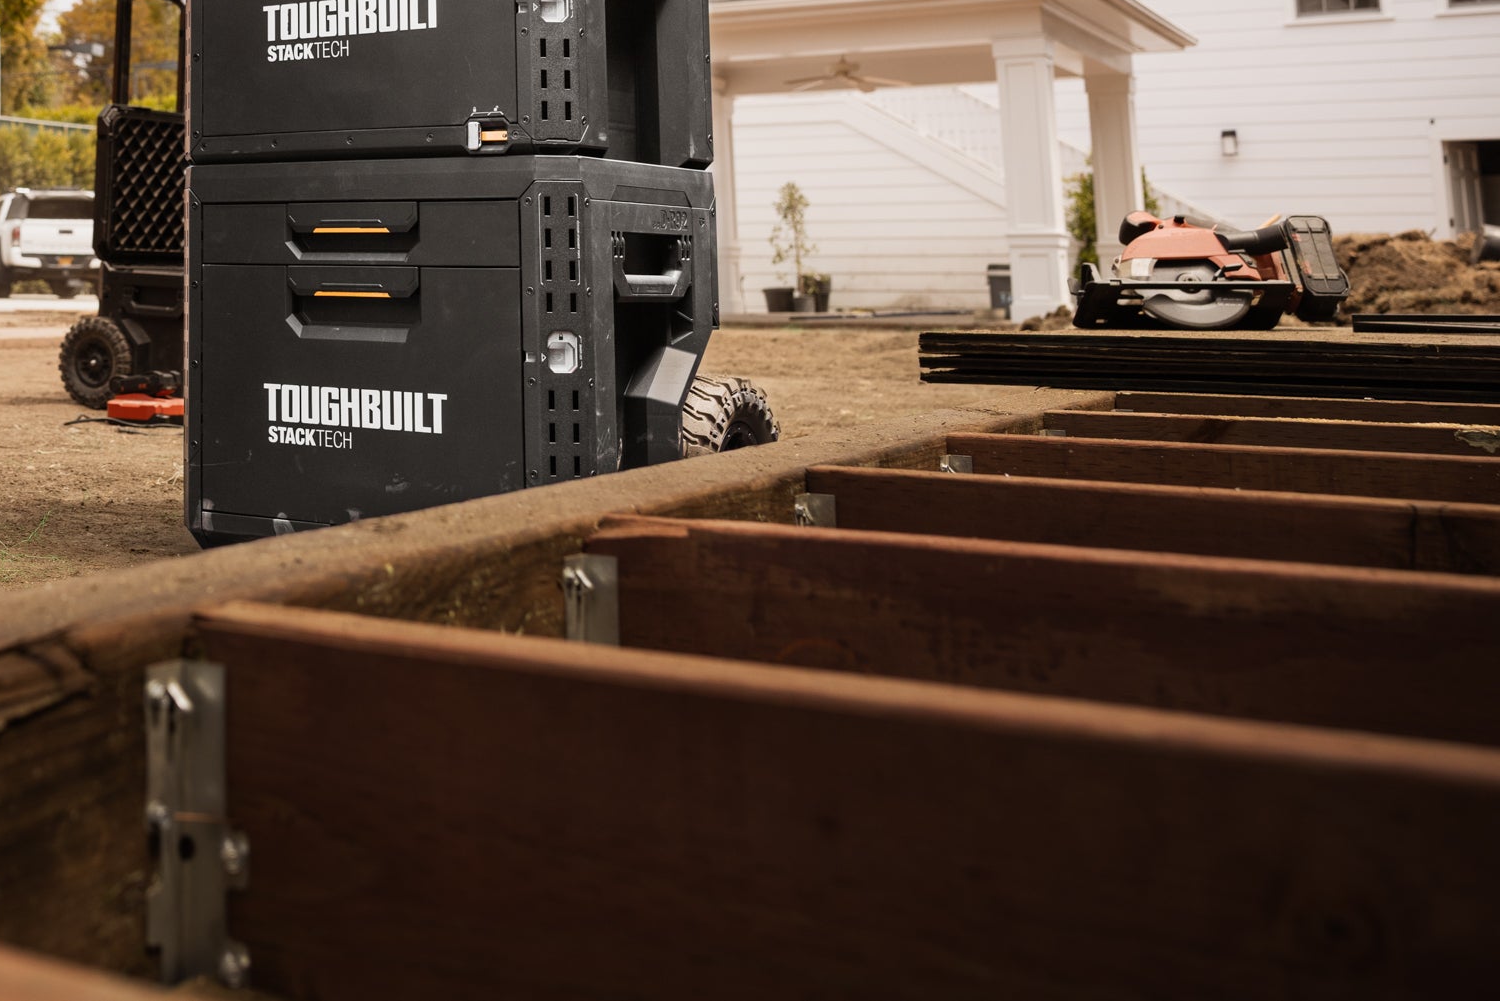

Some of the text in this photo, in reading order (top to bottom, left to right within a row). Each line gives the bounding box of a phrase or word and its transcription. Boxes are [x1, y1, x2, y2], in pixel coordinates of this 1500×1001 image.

[267, 39, 350, 63] STACKTECH
[263, 382, 448, 434] TOUGHBUILT
[268, 425, 353, 450] STACKTECH
